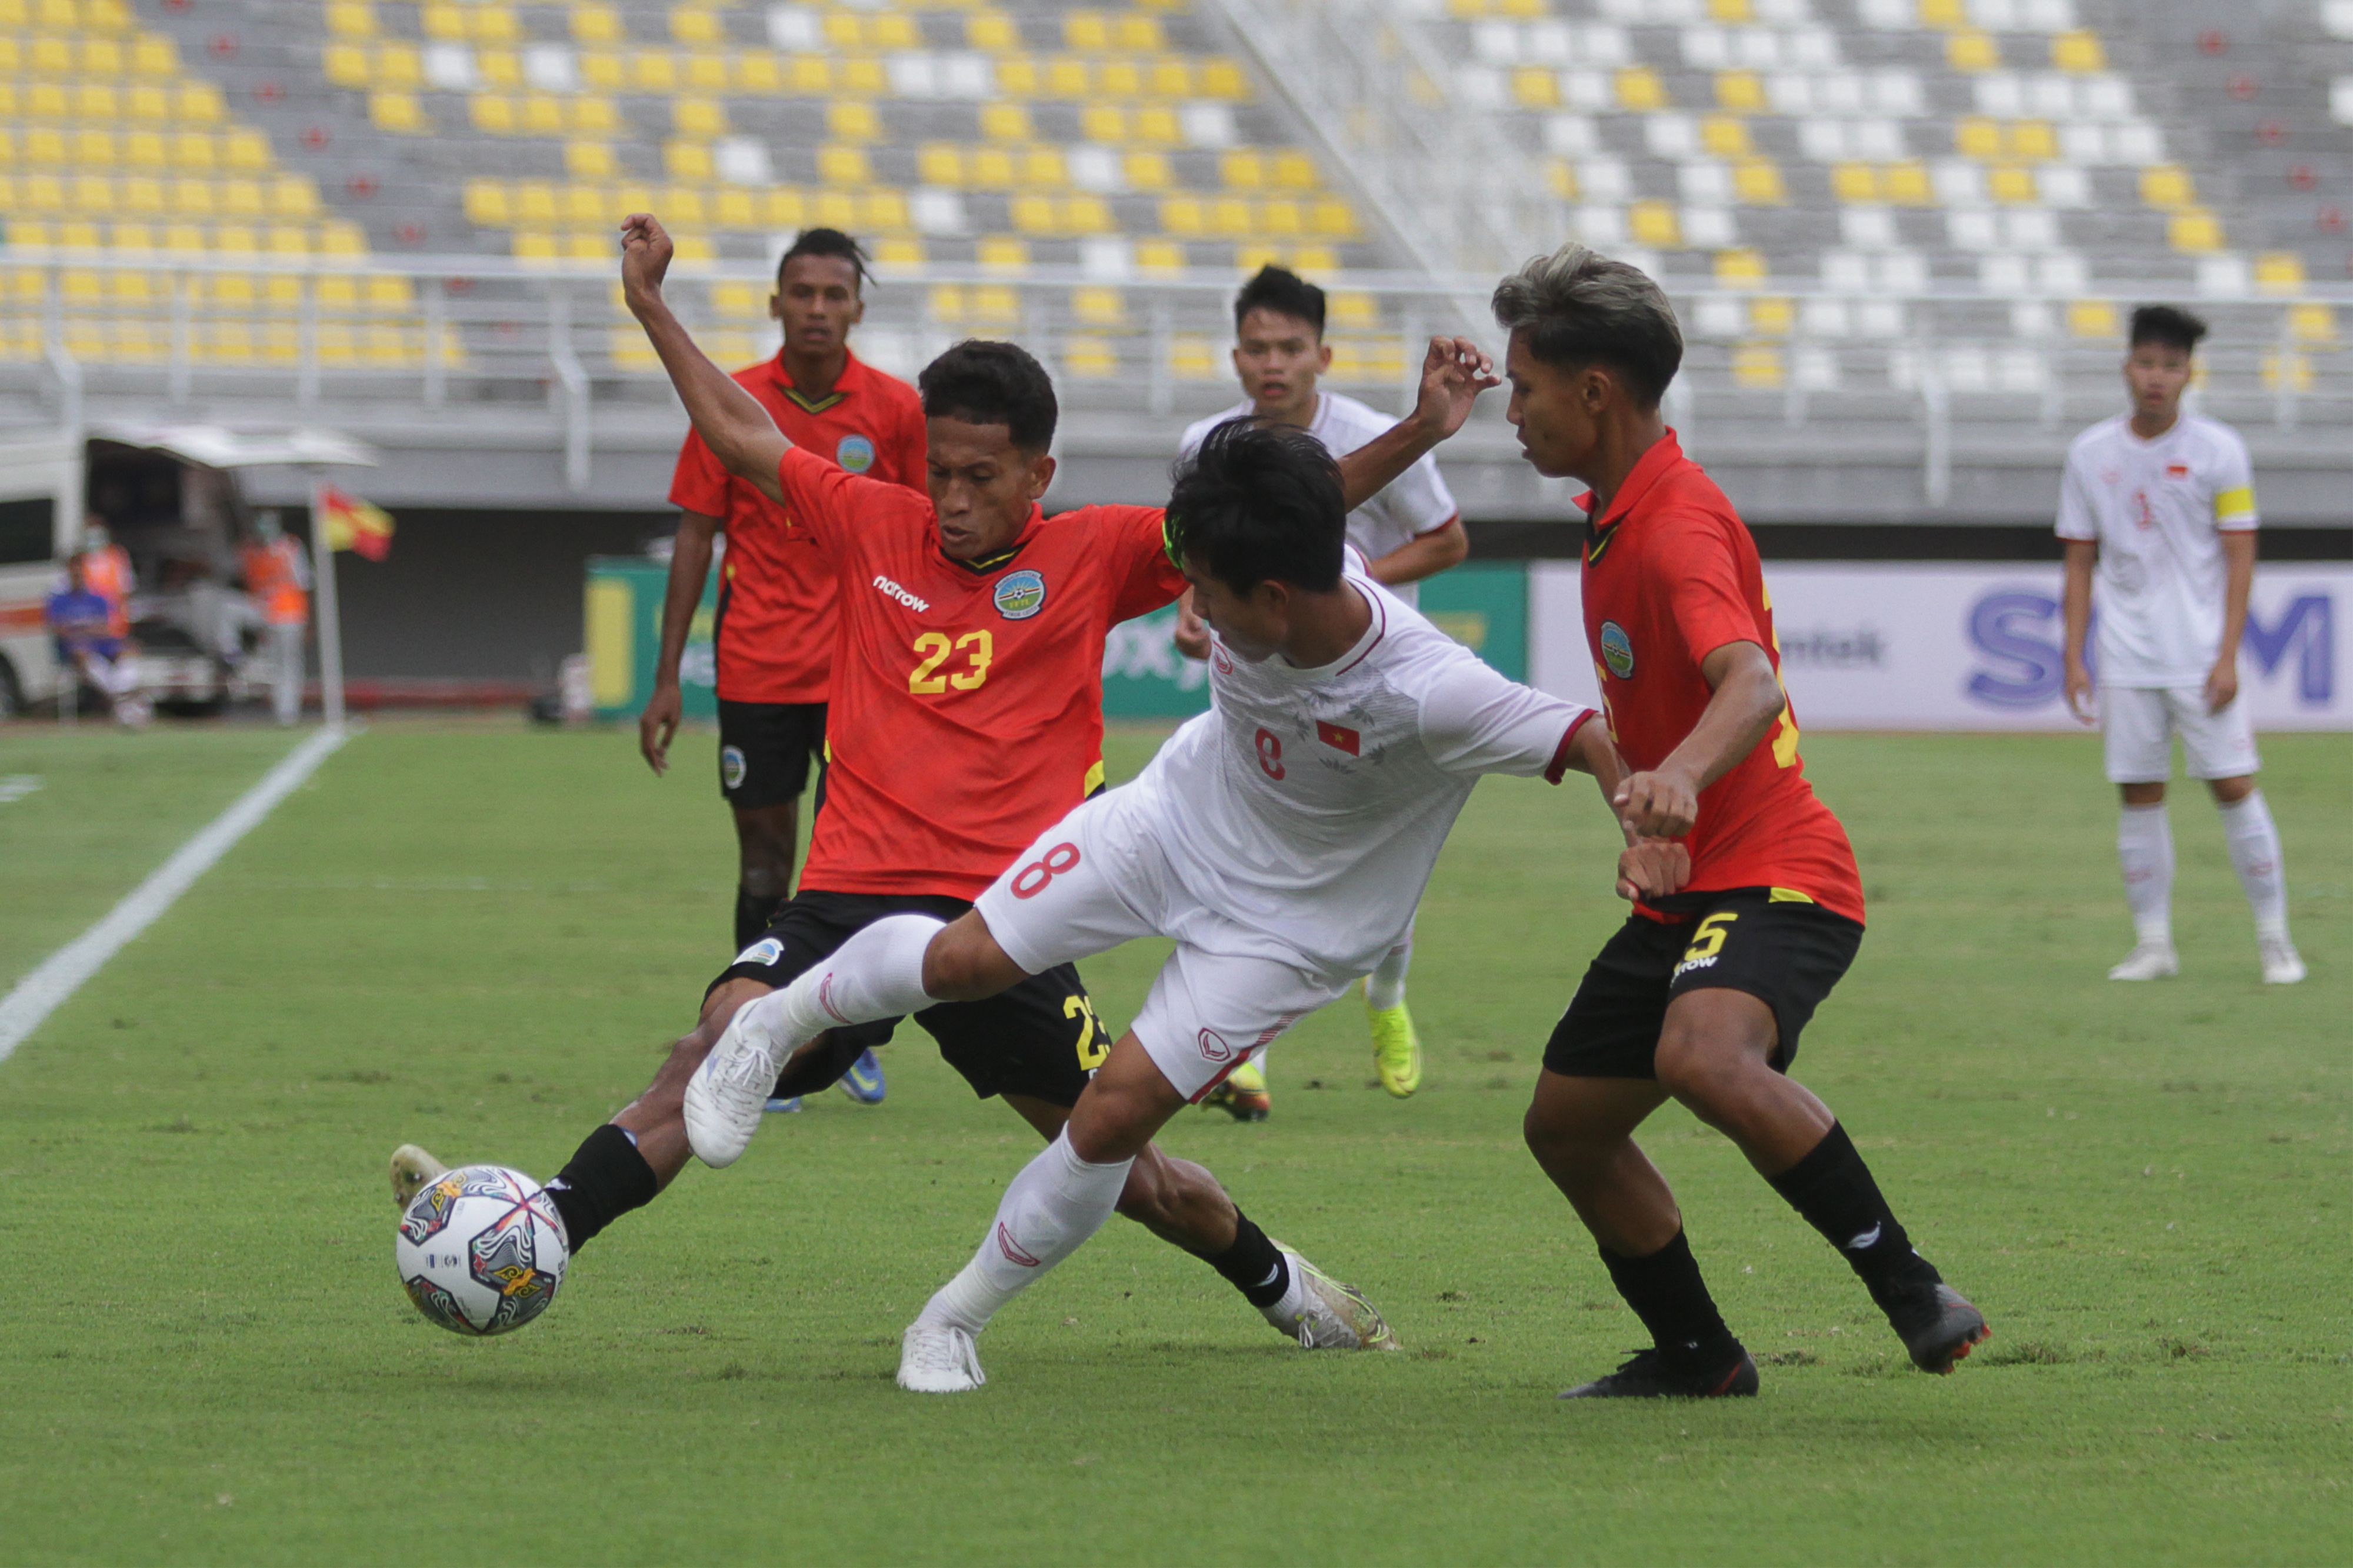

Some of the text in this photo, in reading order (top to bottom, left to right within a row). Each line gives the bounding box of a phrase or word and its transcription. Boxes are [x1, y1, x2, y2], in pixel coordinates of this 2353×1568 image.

[873, 575, 930, 612] narrow
[909, 629, 993, 694] 23
[1969, 593, 2329, 707] SM
[1255, 728, 1287, 782] 8
[1010, 842, 1081, 900] 8
[1674, 912, 1738, 972] 5
